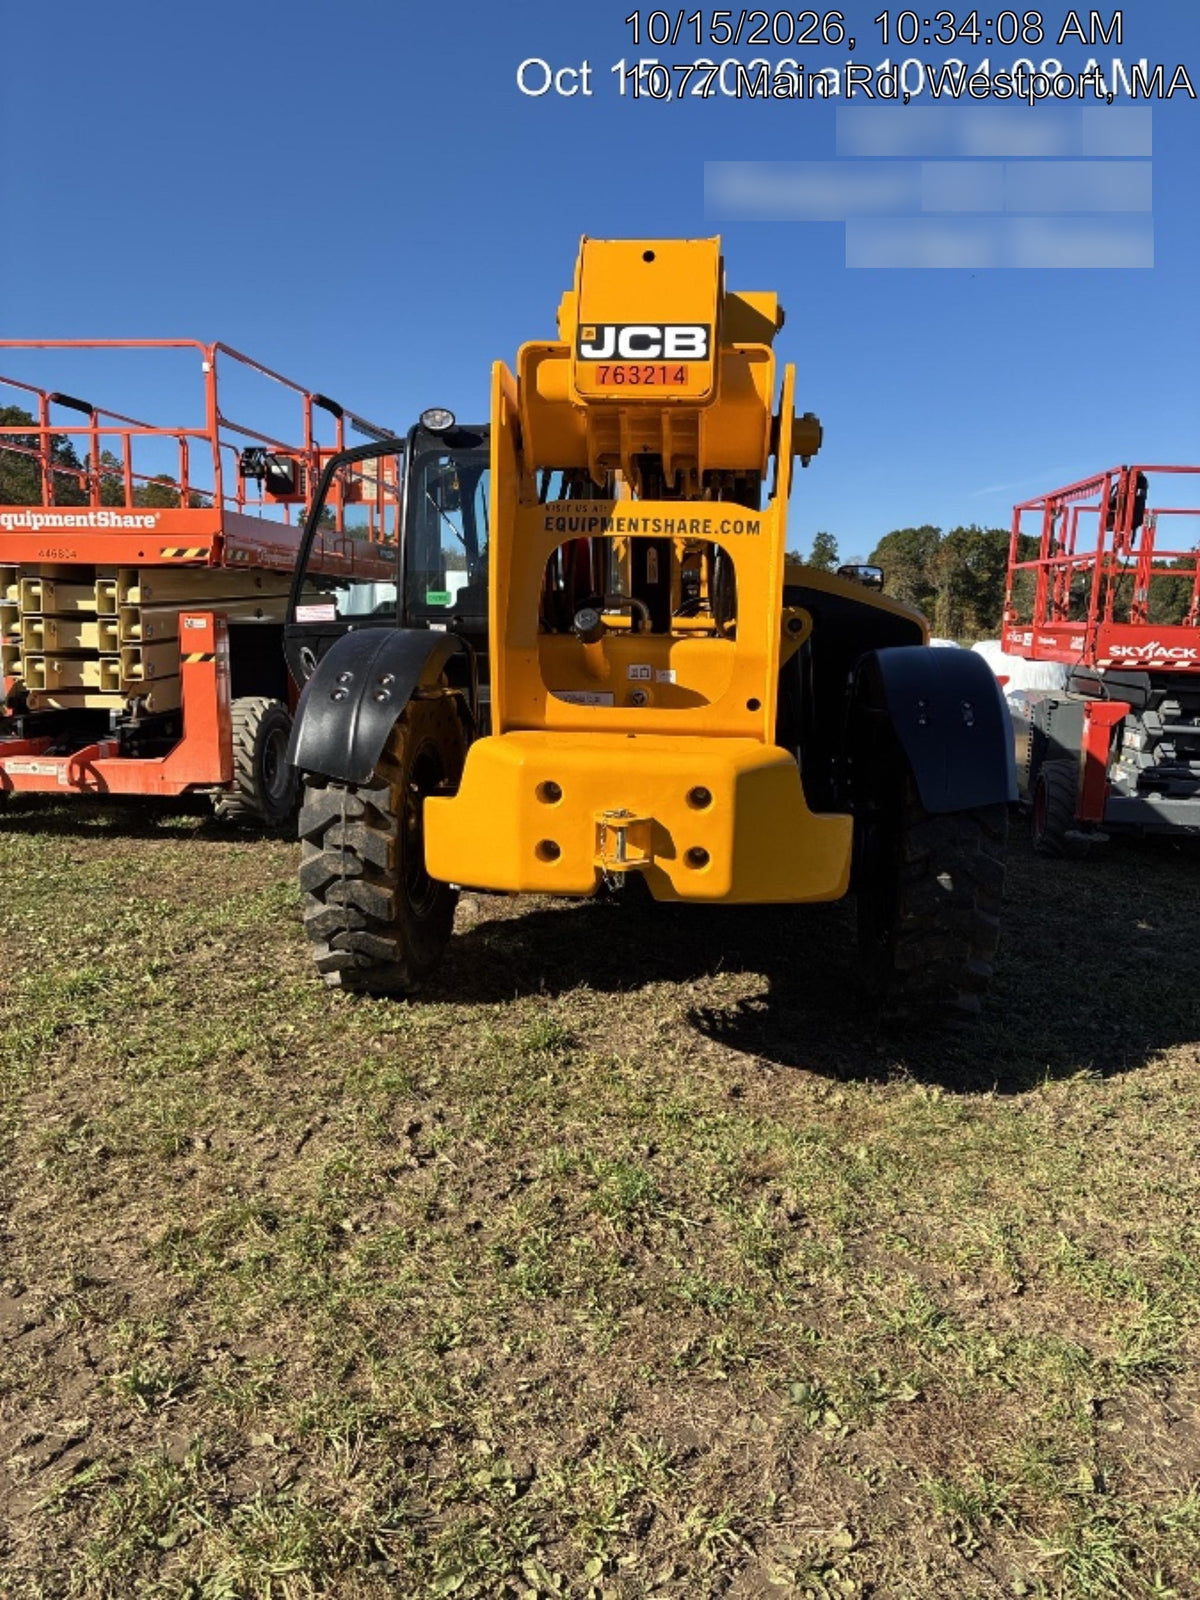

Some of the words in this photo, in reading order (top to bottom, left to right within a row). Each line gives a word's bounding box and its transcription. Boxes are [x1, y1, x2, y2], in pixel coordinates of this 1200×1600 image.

[580, 326, 707, 358] JCB
[598, 365, 686, 385] 763214
[545, 503, 572, 513] VISIT
[575, 503, 588, 513] US
[0, 509, 157, 531] quipmentShare
[544, 515, 761, 536] EQUIPMENTSHARE.COM
[1108, 641, 1198, 660] SKYJACK
